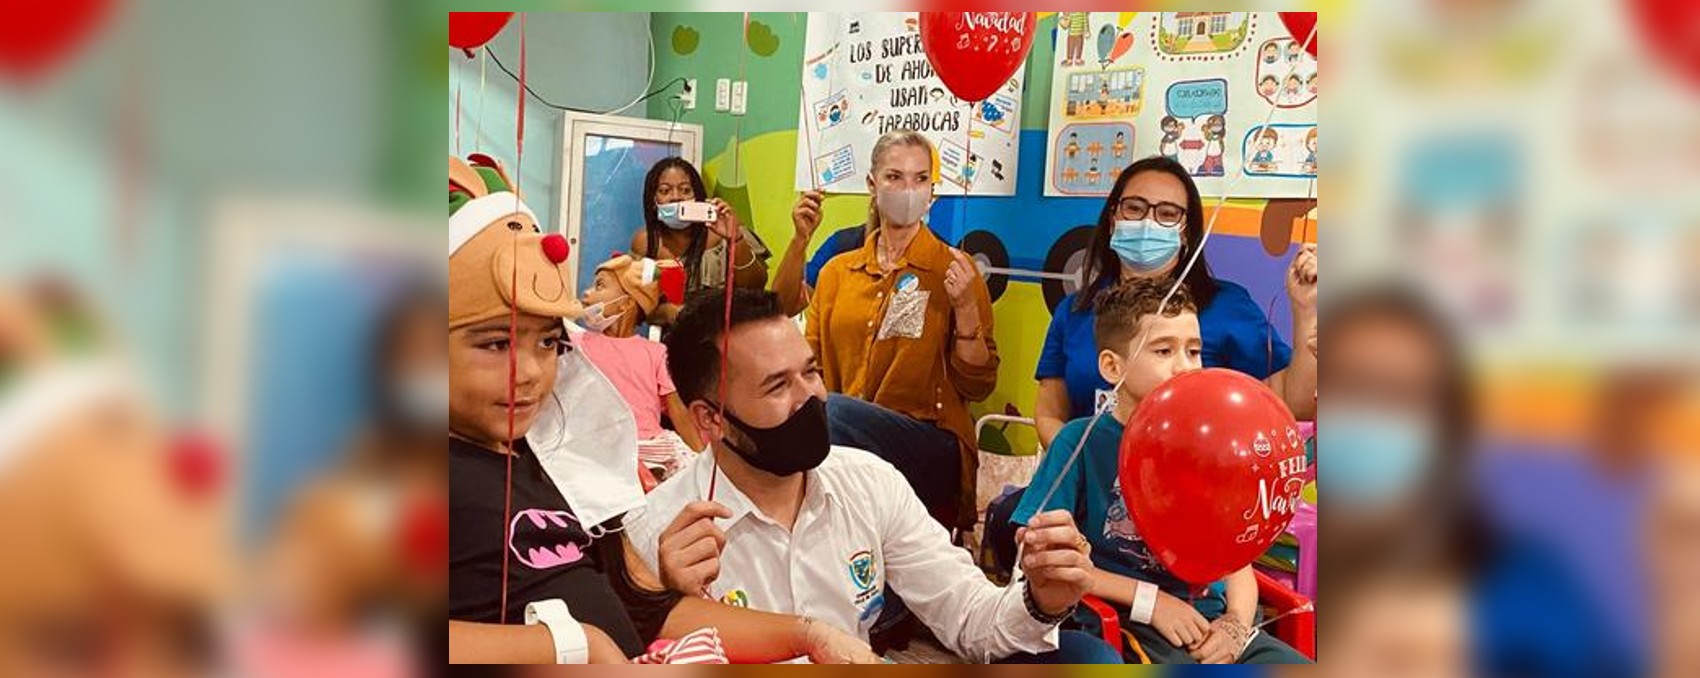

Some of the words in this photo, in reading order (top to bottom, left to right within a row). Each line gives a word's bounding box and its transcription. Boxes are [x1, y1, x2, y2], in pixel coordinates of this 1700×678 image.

[956, 12, 1027, 36] Navidad
[850, 41, 872, 63] LOS
[875, 64, 893, 84] DE
[901, 59, 935, 80] AHO
[890, 86, 928, 108] USAN
[878, 110, 960, 135] TAPABOCAS
